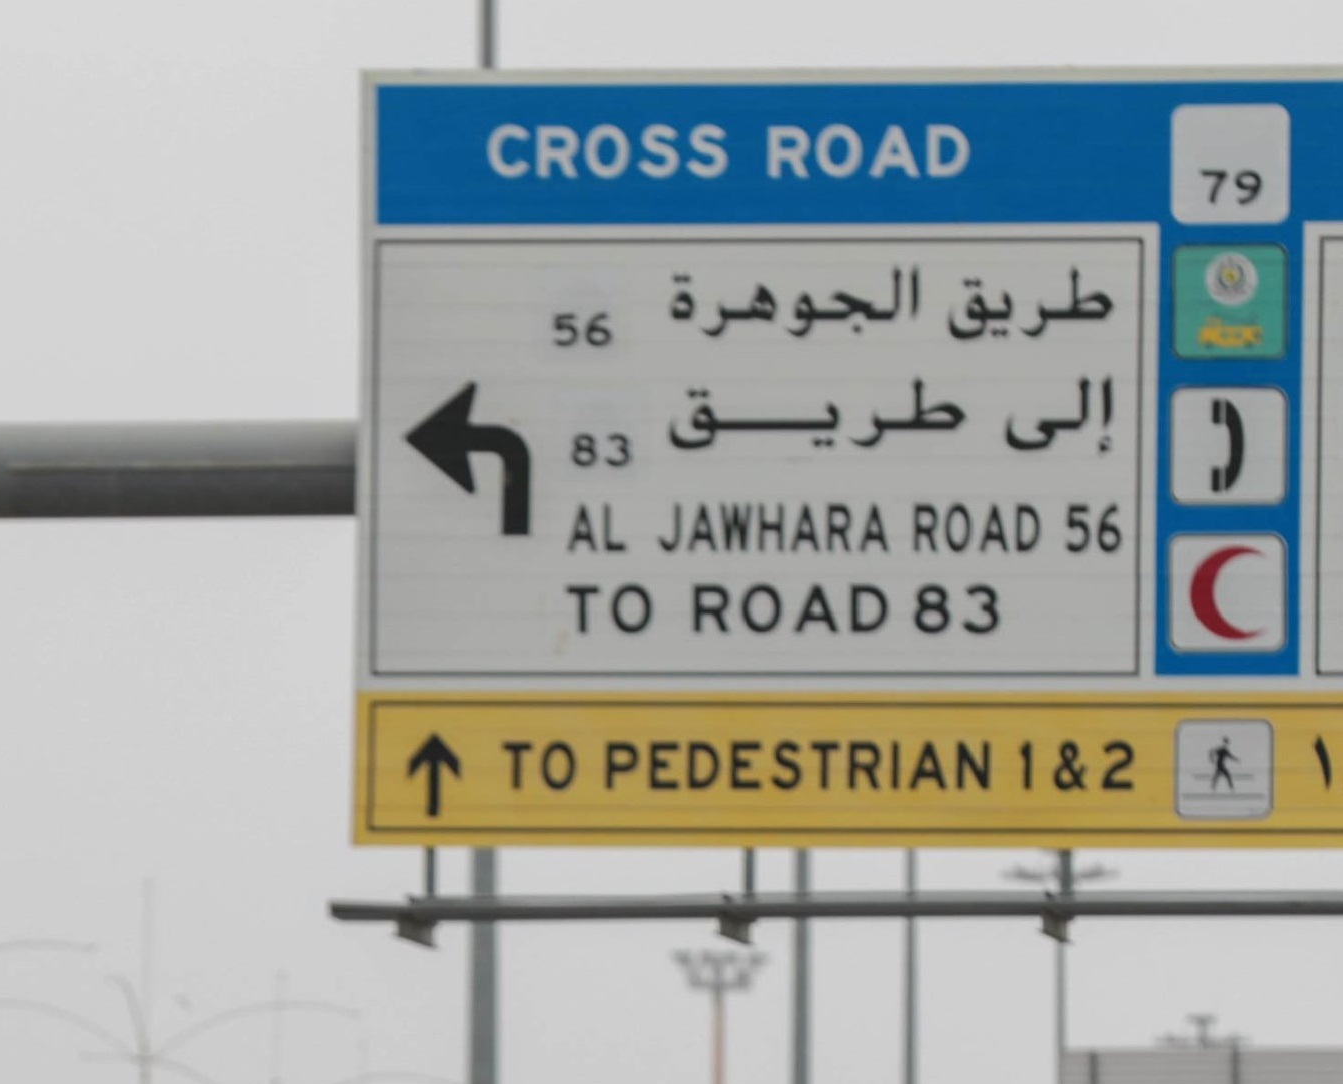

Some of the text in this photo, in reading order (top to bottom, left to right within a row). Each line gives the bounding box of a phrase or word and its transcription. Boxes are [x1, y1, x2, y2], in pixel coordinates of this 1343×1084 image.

[487, 123, 971, 179] CROSS ROAD
[1200, 169, 1263, 206] 79
[553, 268, 1114, 348] طريق الجوهرة 56
[571, 377, 1113, 468] إلى طريق 83
[567, 502, 1122, 554] AL JAWHARA ROAD 56
[566, 583, 1000, 635] TO ROAD 83
[501, 740, 577, 792] TO
[605, 740, 991, 791] PEDESTRIAN
